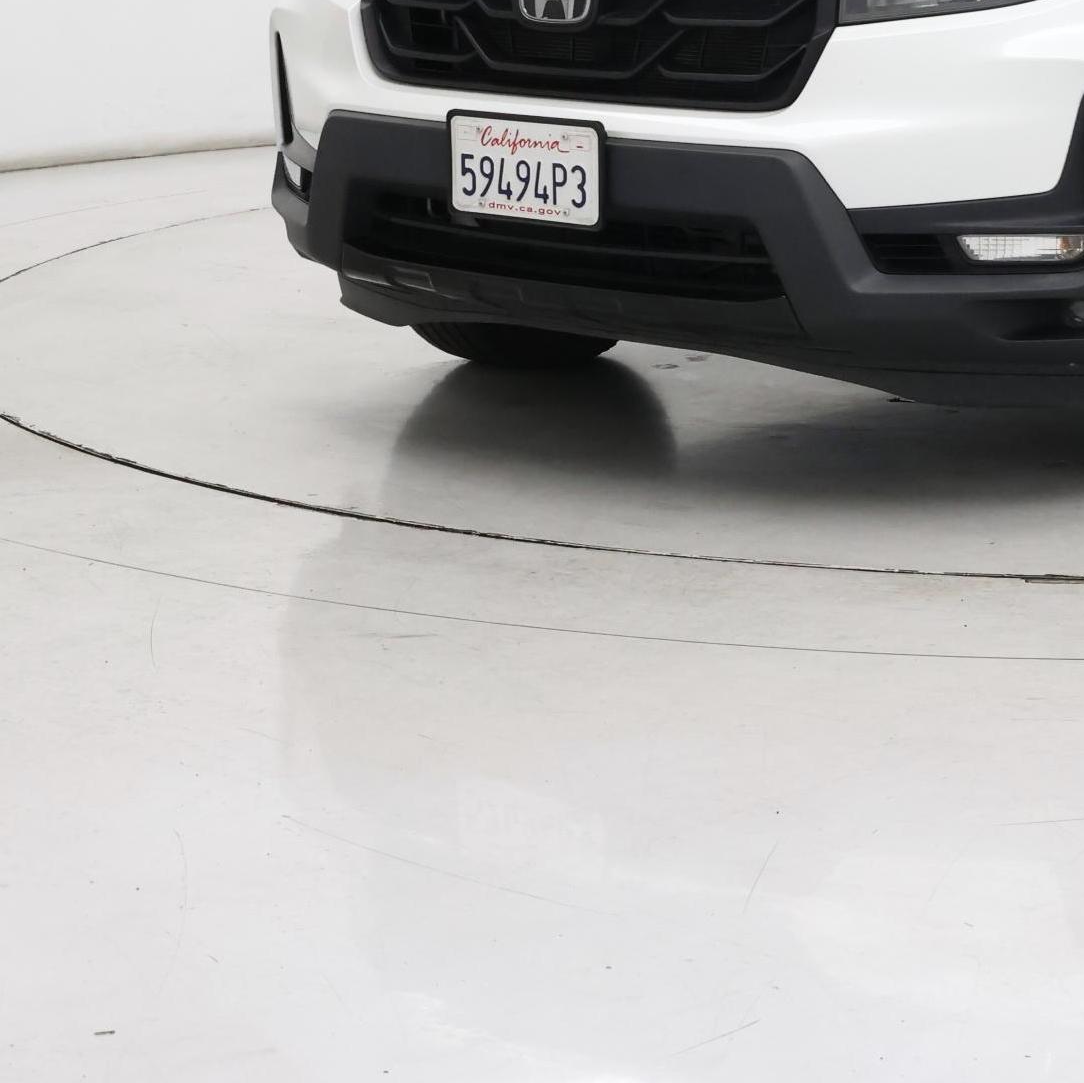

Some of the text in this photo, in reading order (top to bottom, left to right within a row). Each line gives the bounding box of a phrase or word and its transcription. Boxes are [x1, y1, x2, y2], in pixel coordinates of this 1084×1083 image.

[480, 125, 569, 155] California
[460, 153, 587, 209] 59494P3
[488, 200, 562, 216] dmv.ca.gov
